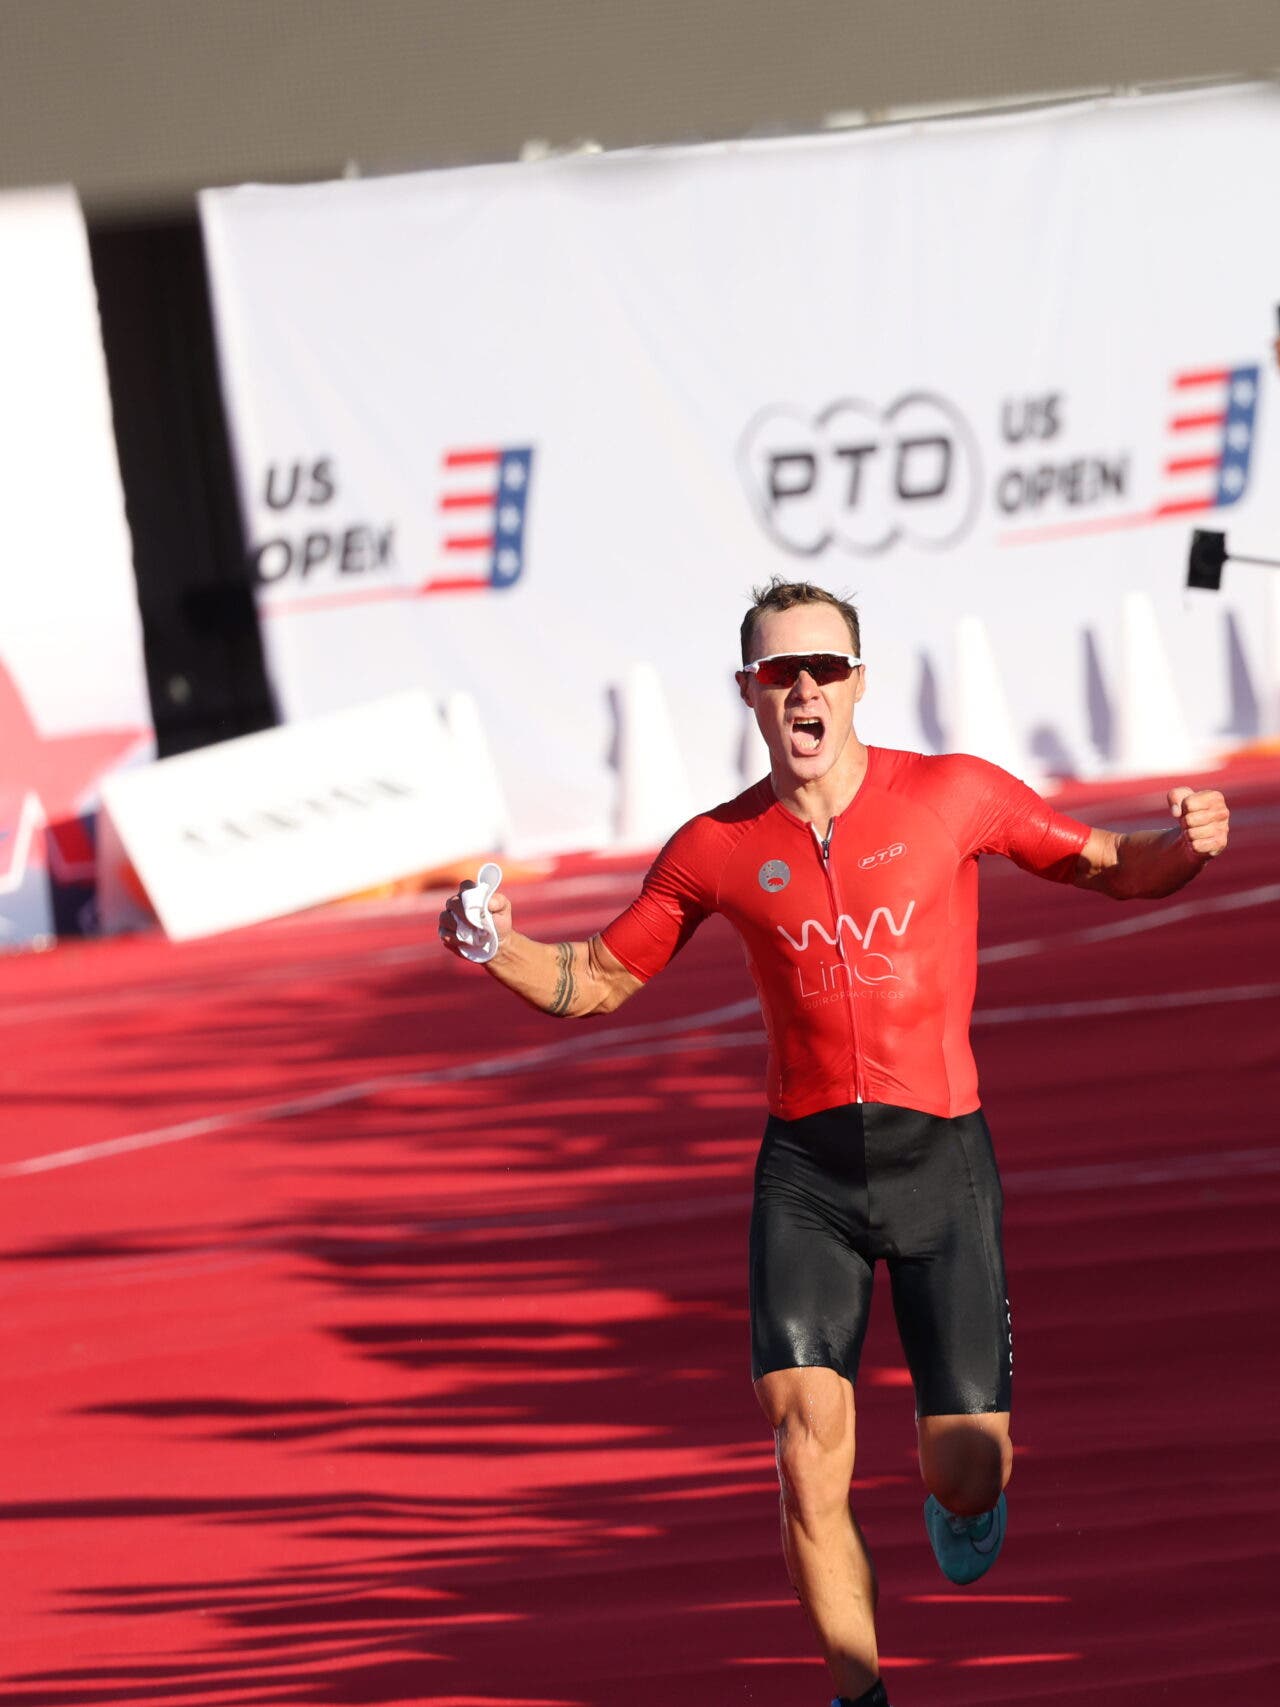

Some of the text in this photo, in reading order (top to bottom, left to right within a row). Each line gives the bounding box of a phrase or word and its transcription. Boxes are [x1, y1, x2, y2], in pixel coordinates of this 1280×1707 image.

[1000, 394, 1062, 445] US
[264, 455, 336, 512] US
[766, 434, 954, 508] PTO
[997, 450, 1130, 514] OPEN
[860, 844, 904, 868] PTO
